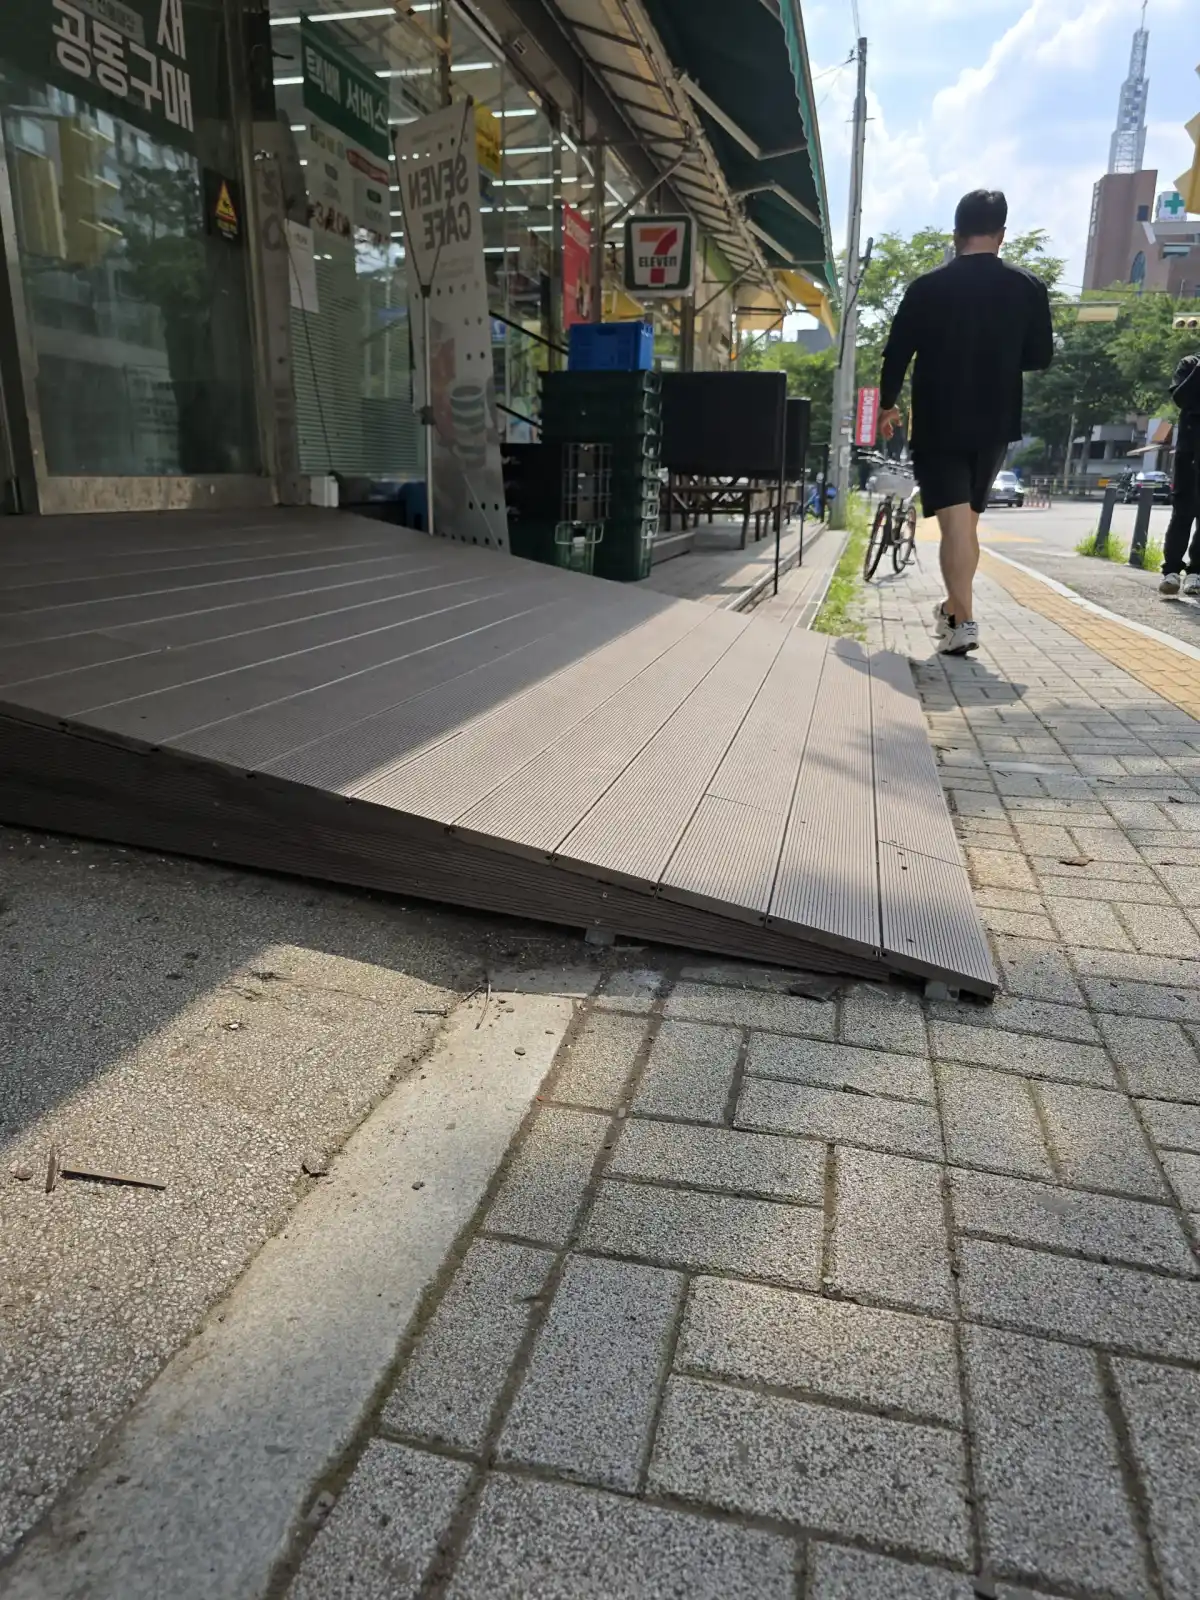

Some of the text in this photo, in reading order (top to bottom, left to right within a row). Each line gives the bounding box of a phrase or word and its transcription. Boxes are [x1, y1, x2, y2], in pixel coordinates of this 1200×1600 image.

[52, 0, 194, 133] 공동구매
[346, 77, 388, 137] 서비스
[639, 227, 678, 284] 7
